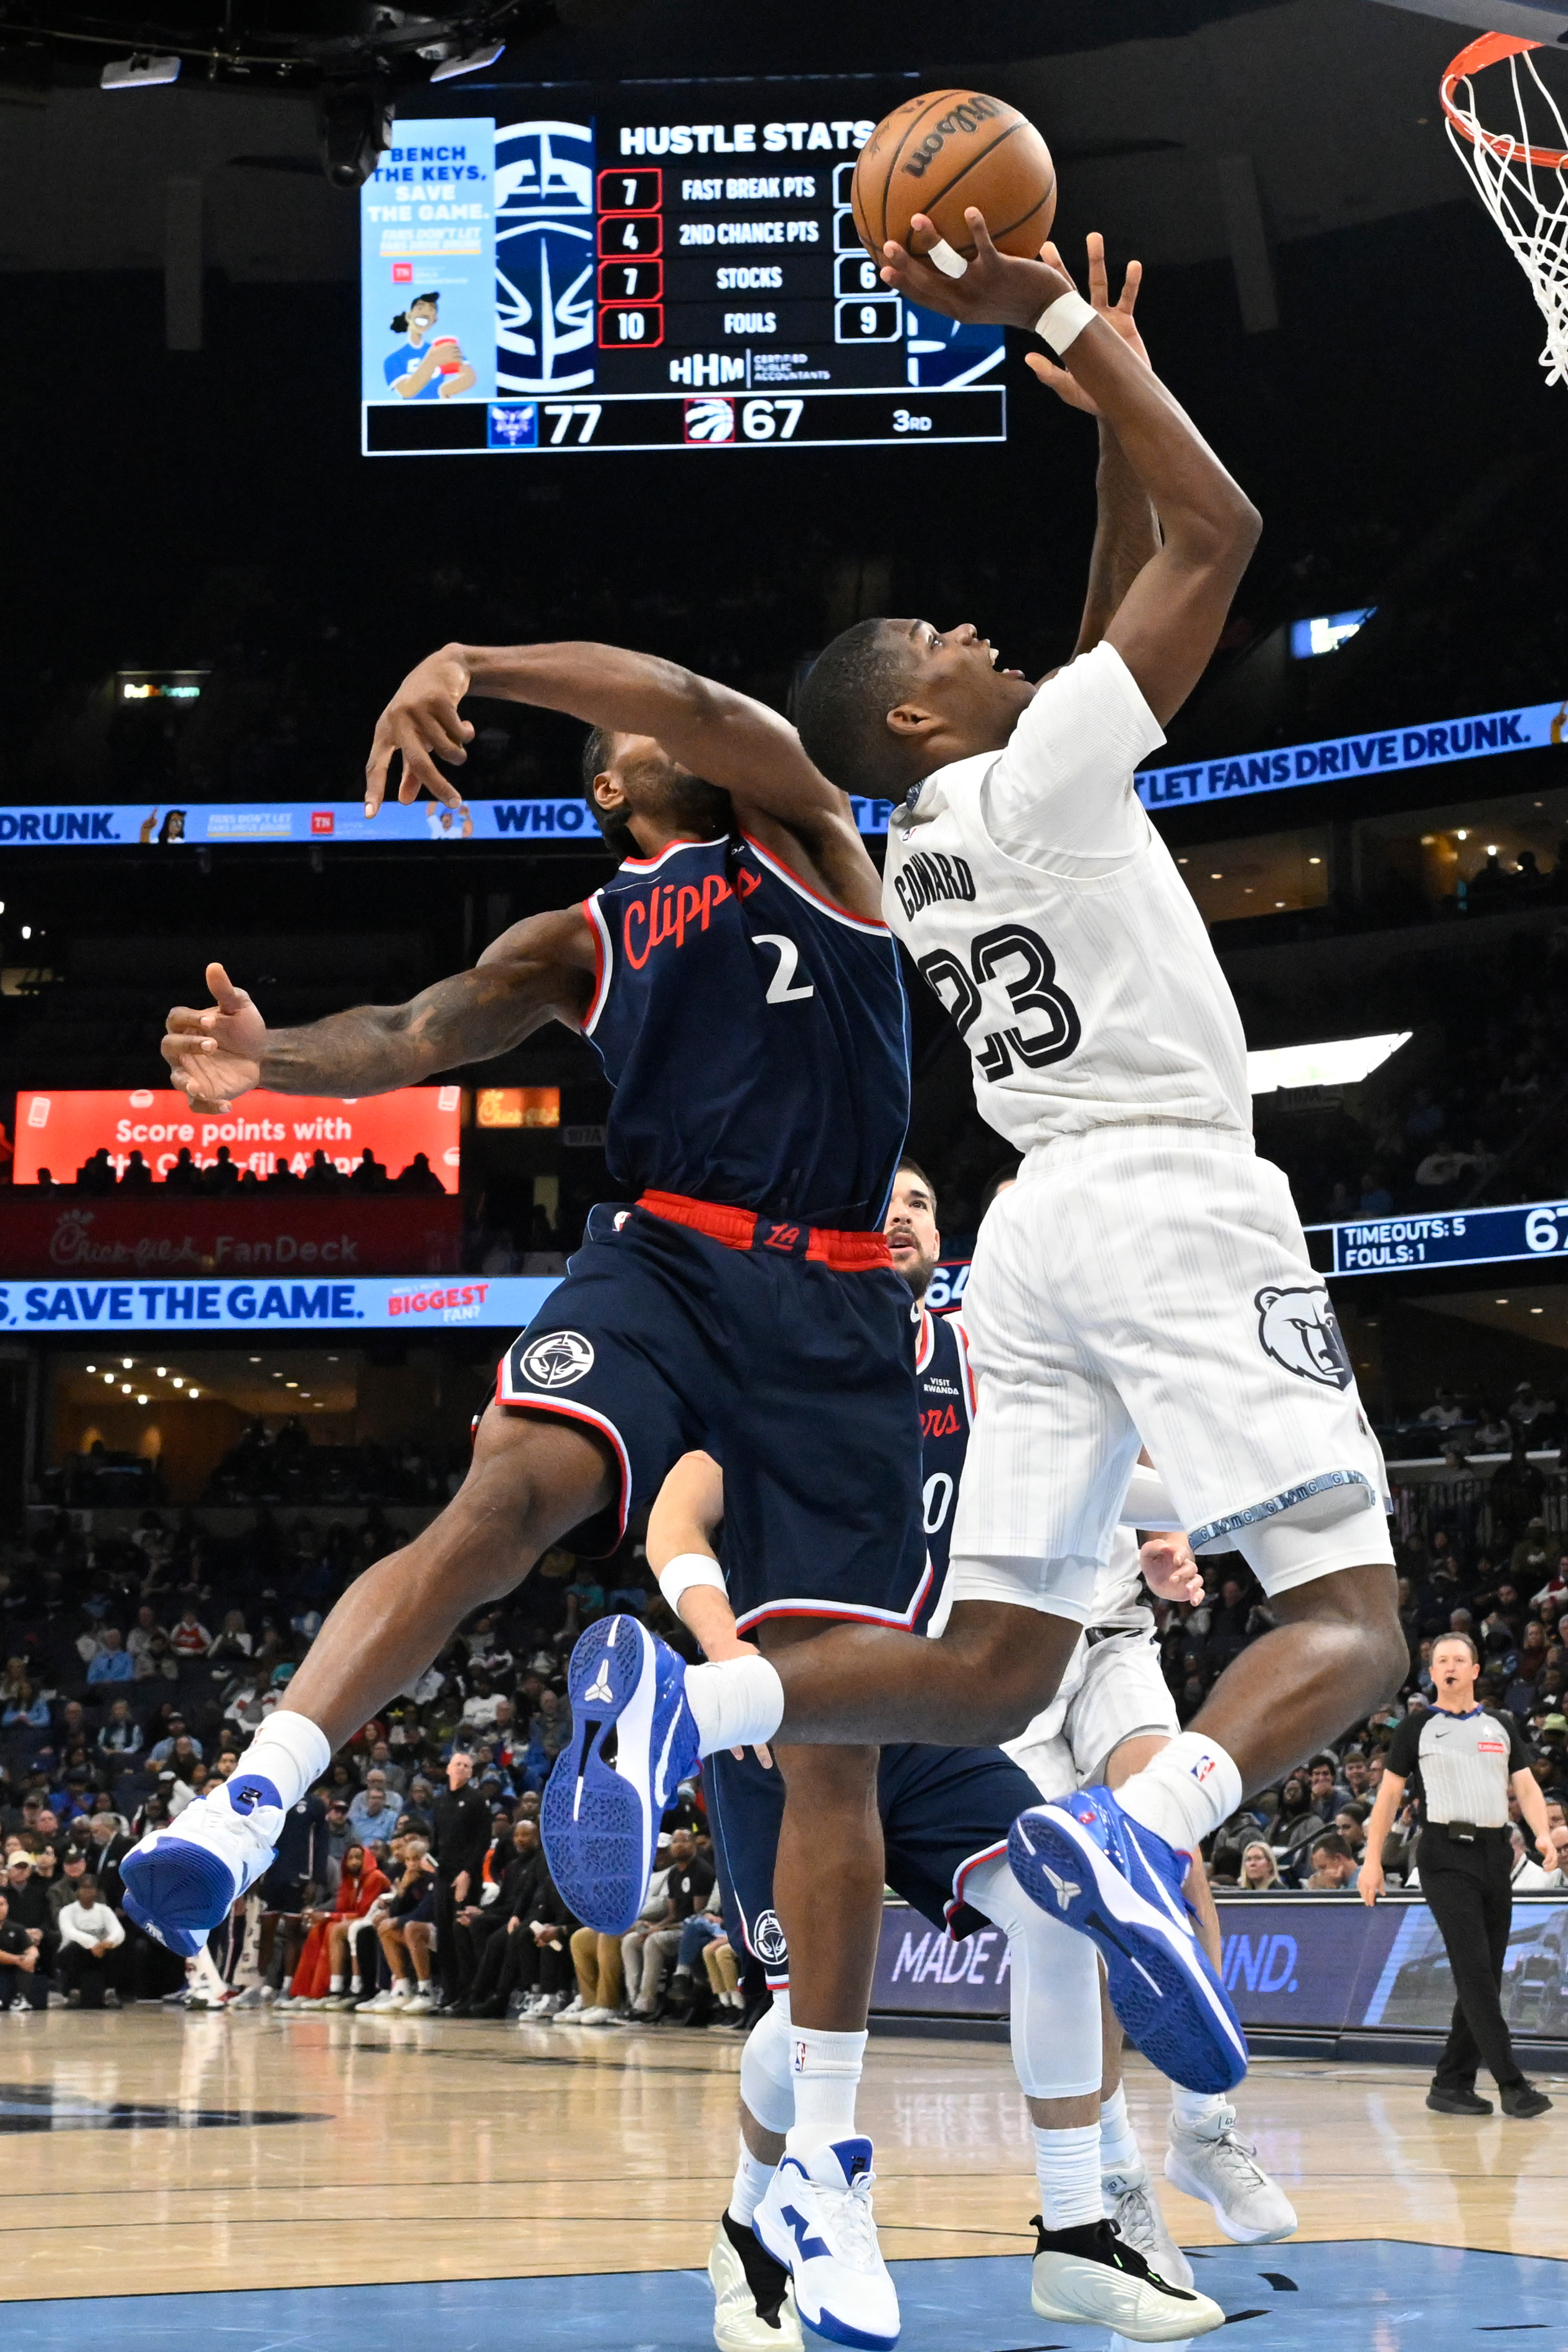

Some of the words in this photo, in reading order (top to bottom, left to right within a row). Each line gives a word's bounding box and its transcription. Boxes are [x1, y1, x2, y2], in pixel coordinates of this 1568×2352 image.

[621, 126, 756, 156] HUSTLE
[763, 121, 876, 152] STATS
[901, 94, 1001, 179] Wilson
[390, 146, 466, 162] BENCH
[374, 167, 413, 182] THE
[422, 166, 486, 181] KEYS,
[682, 179, 723, 200] FAST
[726, 177, 780, 199] BREAK
[783, 176, 815, 198] PTS
[395, 184, 456, 202] SAVE
[622, 179, 637, 205] 7
[367, 205, 412, 222] THE
[418, 204, 491, 220] GAME.
[623, 223, 639, 250] 4
[679, 224, 715, 245] 2ND
[717, 222, 784, 244] CHANCE
[787, 221, 819, 243] PTS
[623, 268, 638, 295] 7
[716, 266, 783, 289] STOCKS
[860, 261, 876, 289] 6
[618, 313, 645, 340] 10
[724, 312, 777, 334] FOULS
[860, 306, 876, 334] 9
[670, 353, 744, 387] HHM
[545, 404, 602, 443] 77
[743, 399, 804, 440] 67
[893, 409, 932, 432] 3RD
[1150, 767, 1203, 803] LET
[1208, 753, 1290, 794] FANS
[1295, 736, 1397, 779] DRIVE
[1402, 714, 1531, 761] DRUNK.
[0, 812, 120, 840] DRUNK.
[493, 804, 601, 832] WHO
[894, 852, 976, 922] COWARD
[751, 934, 814, 1004] 2
[918, 923, 1081, 1083] 23
[116, 1118, 194, 1143] Score
[202, 1117, 286, 1147] points
[293, 1116, 352, 1141] with
[1344, 1220, 1450, 1246] TIMEOUTS:
[1453, 1217, 1466, 1236] 5
[1345, 1244, 1414, 1268] FOULS:
[1417, 1244, 1425, 1261] 1
[26, 1286, 133, 1322] SAVE
[139, 1286, 220, 1320] THE
[227, 1284, 364, 1320] GAME.
[388, 1284, 490, 1316] BIGGEST
[443, 1305, 481, 1322] FAN?
[923, 1383, 960, 1395] RWANDA
[929, 1376, 951, 1387] VISIT
[891, 1931, 998, 1985] MADE
